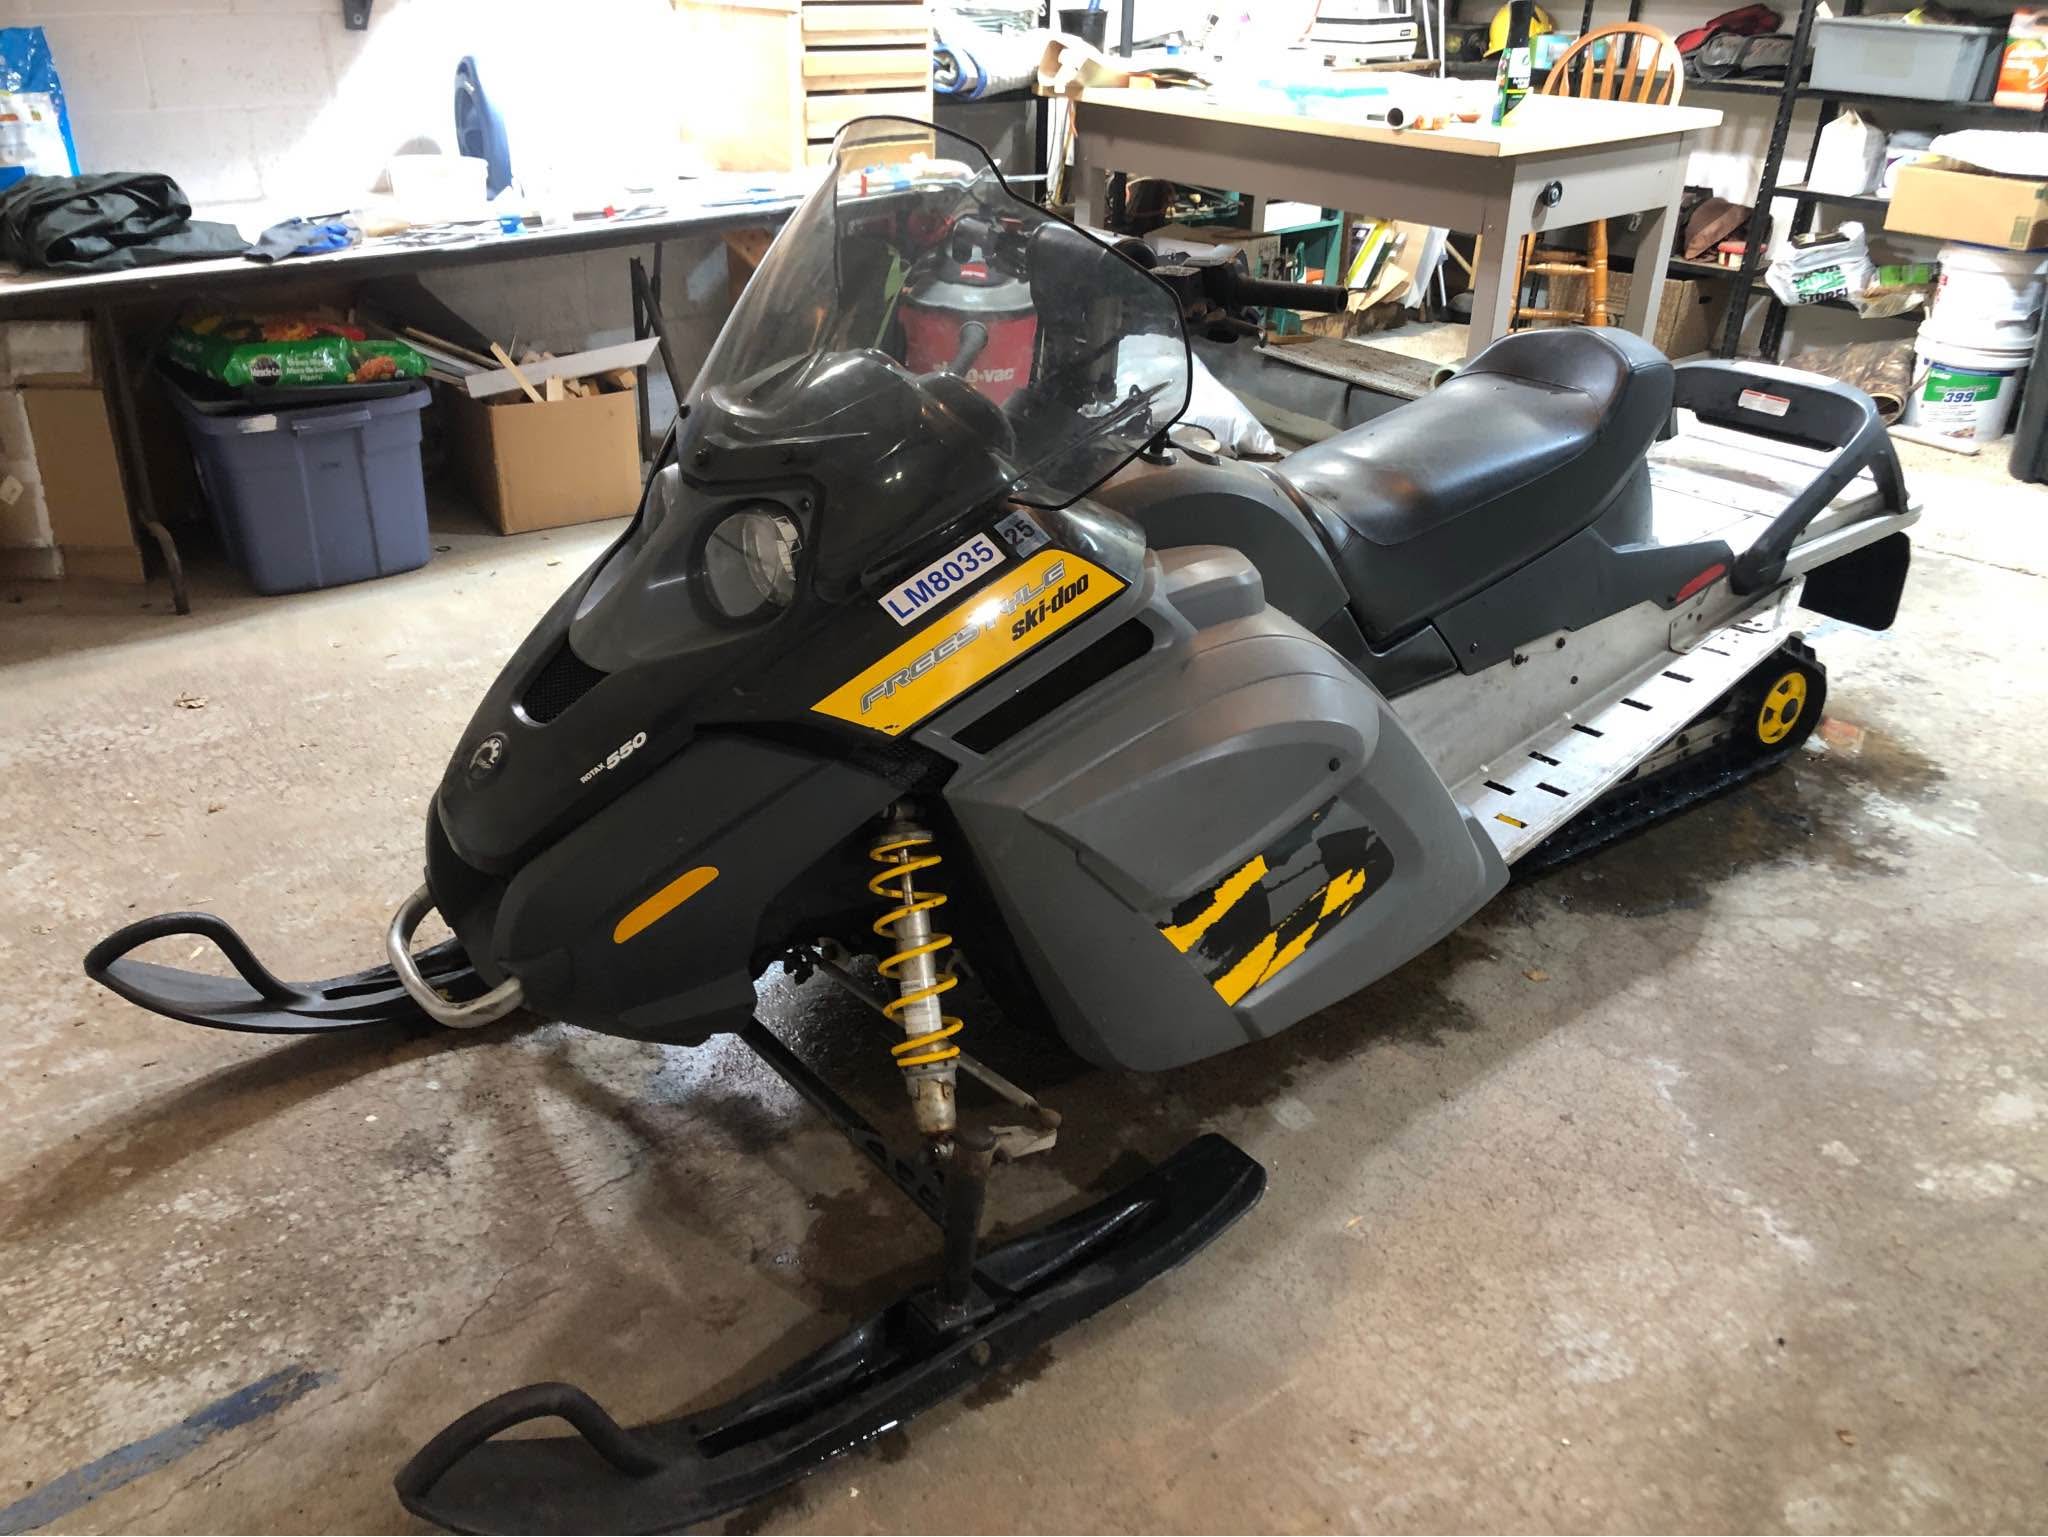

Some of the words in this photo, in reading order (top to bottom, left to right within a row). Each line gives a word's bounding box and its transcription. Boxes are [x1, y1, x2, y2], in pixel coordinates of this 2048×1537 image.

[1944, 391, 1975, 403] 399
[1004, 519, 1036, 546] 25
[887, 540, 994, 619] LM8035
[1011, 574, 1089, 642] ski-doo
[580, 762, 606, 784] ROTAX
[606, 731, 647, 770] 550
